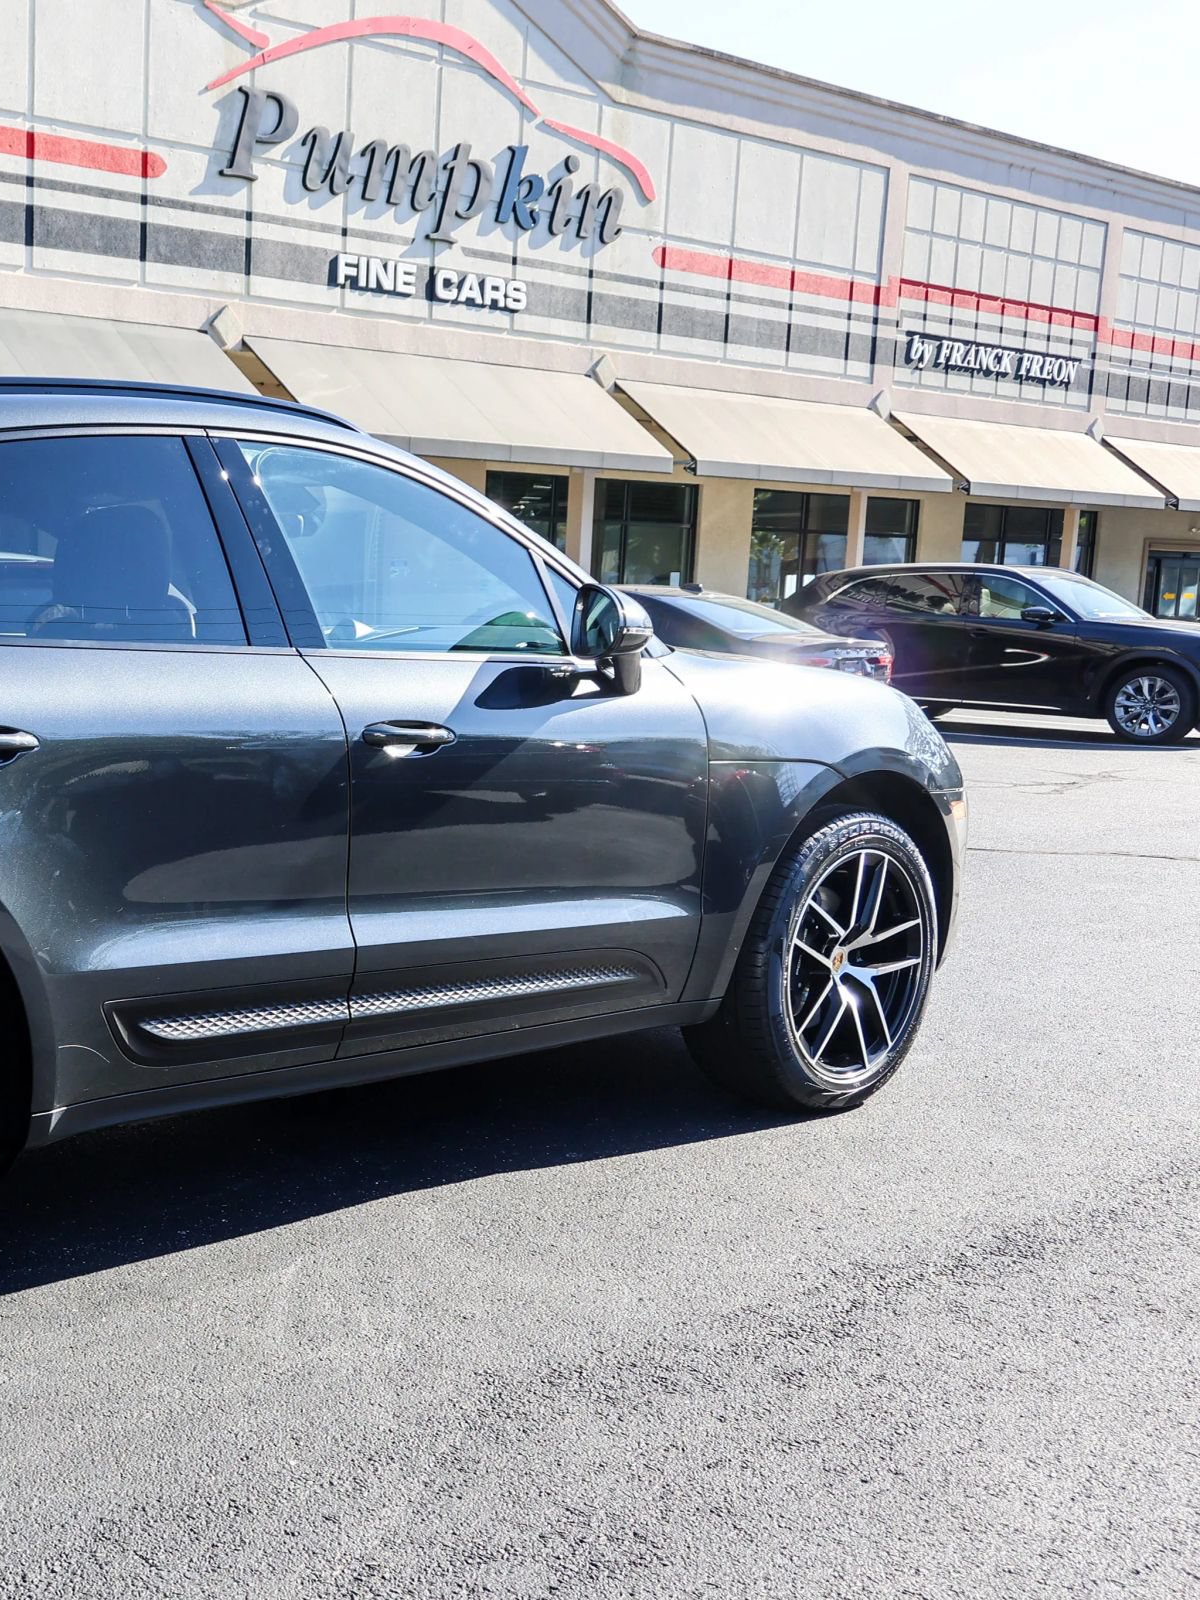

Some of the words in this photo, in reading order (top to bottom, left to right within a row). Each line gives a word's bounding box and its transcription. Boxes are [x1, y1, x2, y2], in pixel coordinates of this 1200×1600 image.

[218, 85, 626, 245] Pumpkin
[336, 252, 417, 294] FINE
[434, 269, 528, 312] CARS
[909, 335, 933, 369] by
[937, 339, 1018, 374] FRANCK
[1017, 352, 1080, 384] FREON
